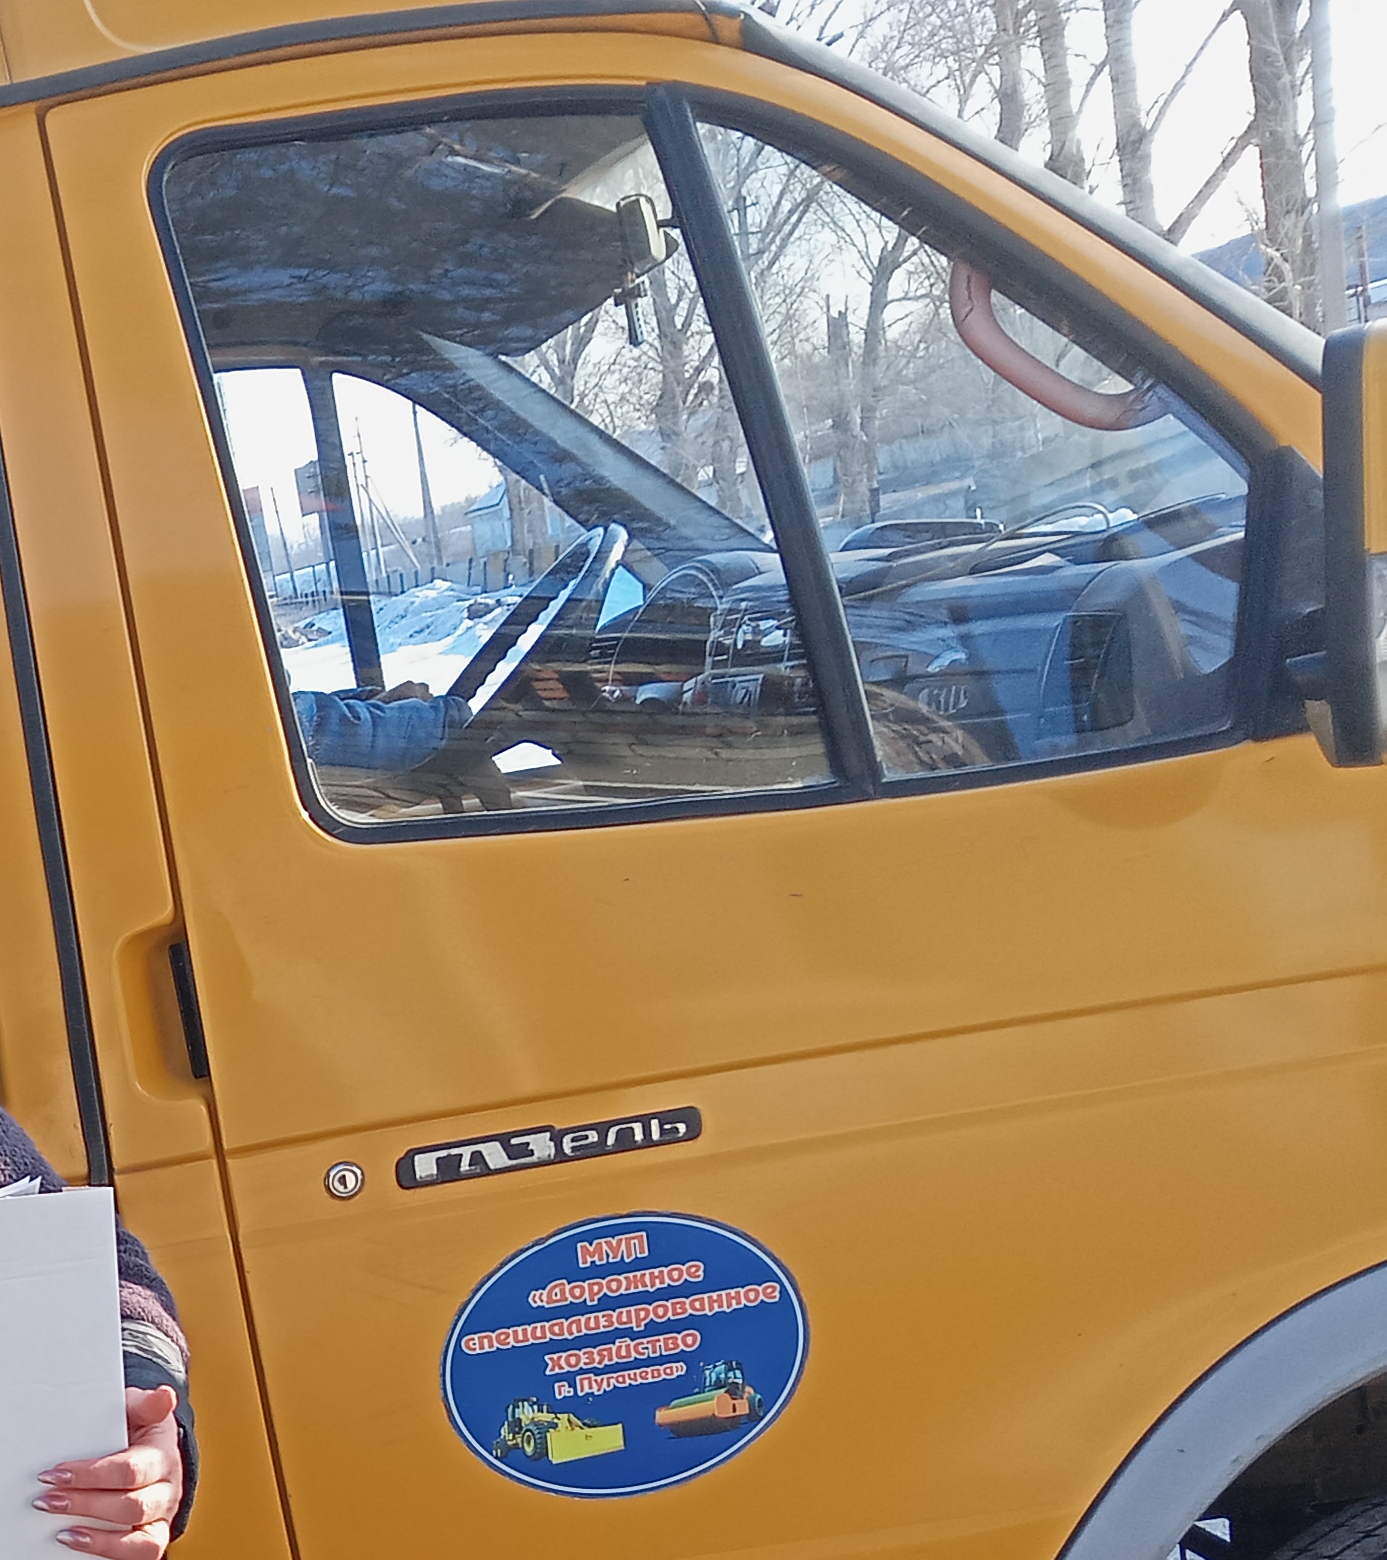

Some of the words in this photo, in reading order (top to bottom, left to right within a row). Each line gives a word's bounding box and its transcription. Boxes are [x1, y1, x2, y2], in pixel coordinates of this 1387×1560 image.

[578, 1232, 648, 1267] МУП
[530, 1262, 704, 1307] «Дорожное
[462, 1283, 780, 1354] специализированное
[546, 1331, 701, 1374] хозяйство
[555, 1382, 574, 1398] г.
[577, 1363, 686, 1395] Пугачева»
